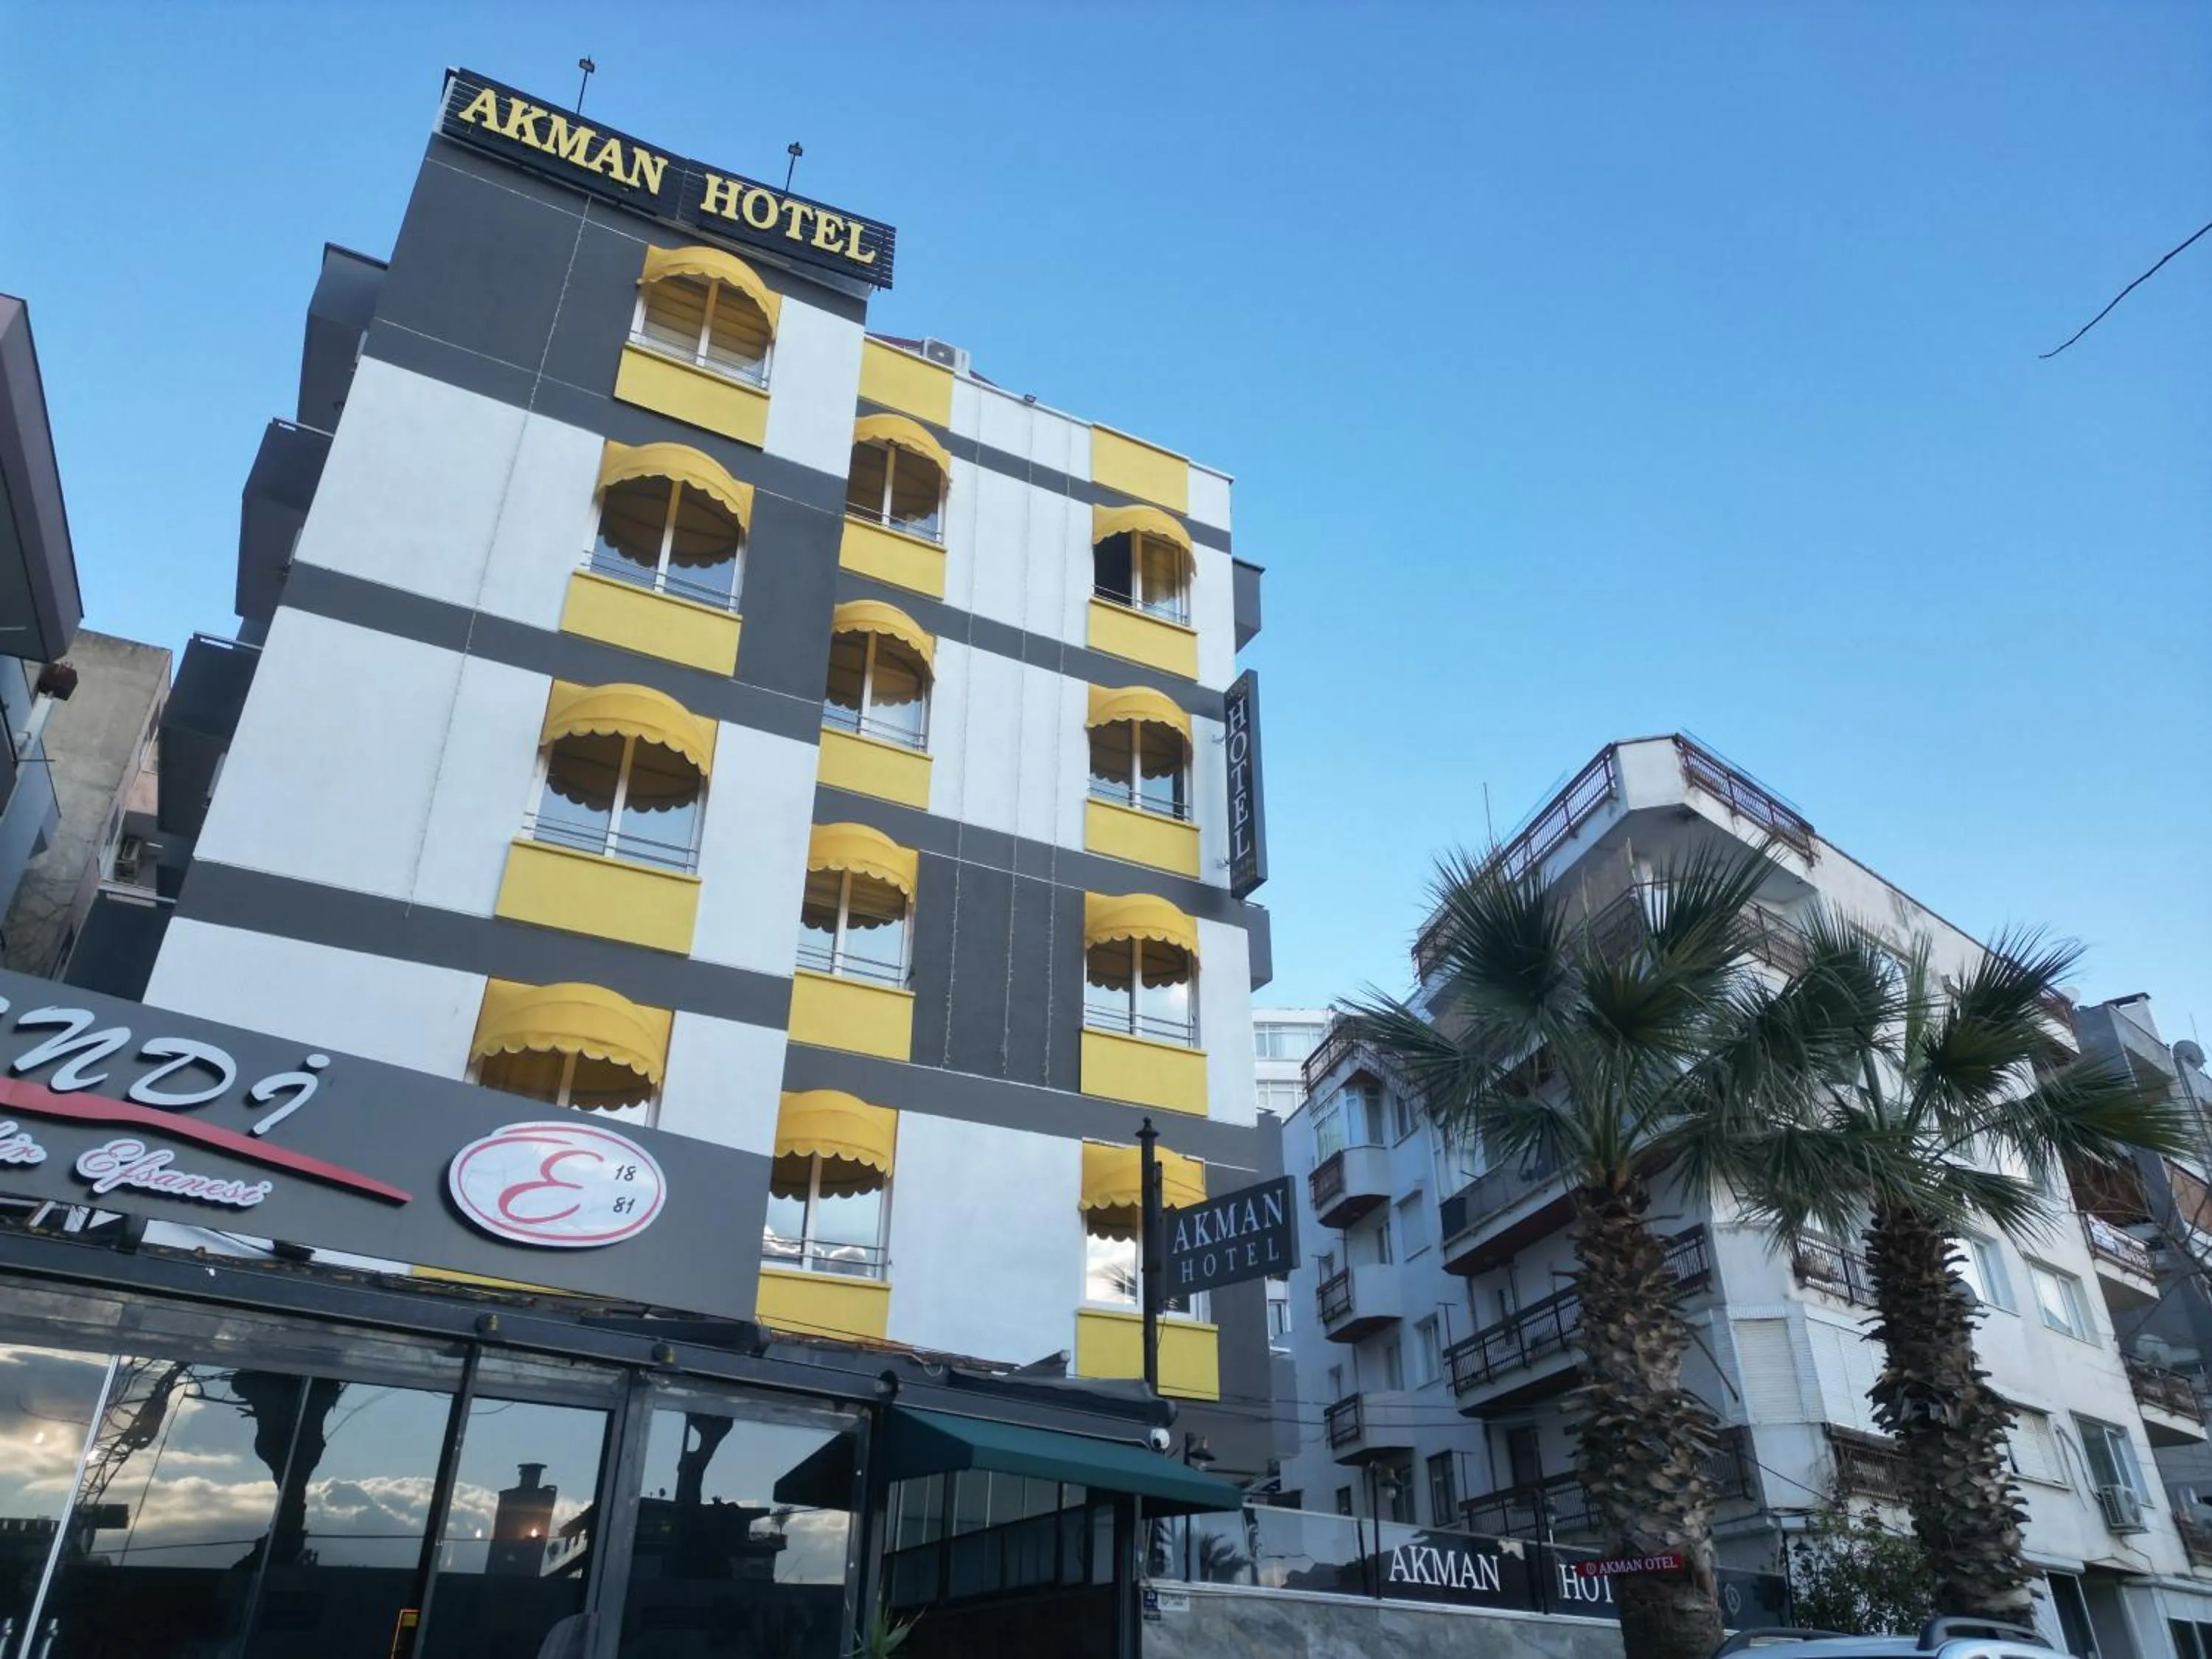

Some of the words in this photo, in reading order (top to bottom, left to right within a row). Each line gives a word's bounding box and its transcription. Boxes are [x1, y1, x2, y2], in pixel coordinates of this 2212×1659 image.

[459, 88, 668, 195] AKMAN
[700, 173, 876, 264] HOTEL
[1228, 698, 1250, 862] HOTEL
[78, 1139, 272, 1205] Efsanesi
[615, 1165, 636, 1181] 18
[613, 1197, 636, 1214] 81
[1172, 1189, 1284, 1254] AKMAN
[1181, 1237, 1279, 1284] HOTEL
[1388, 1545, 1502, 1592] AKMAN
[1599, 1559, 1642, 1574] AKMAN
[1645, 1557, 1679, 1571] OTEL
